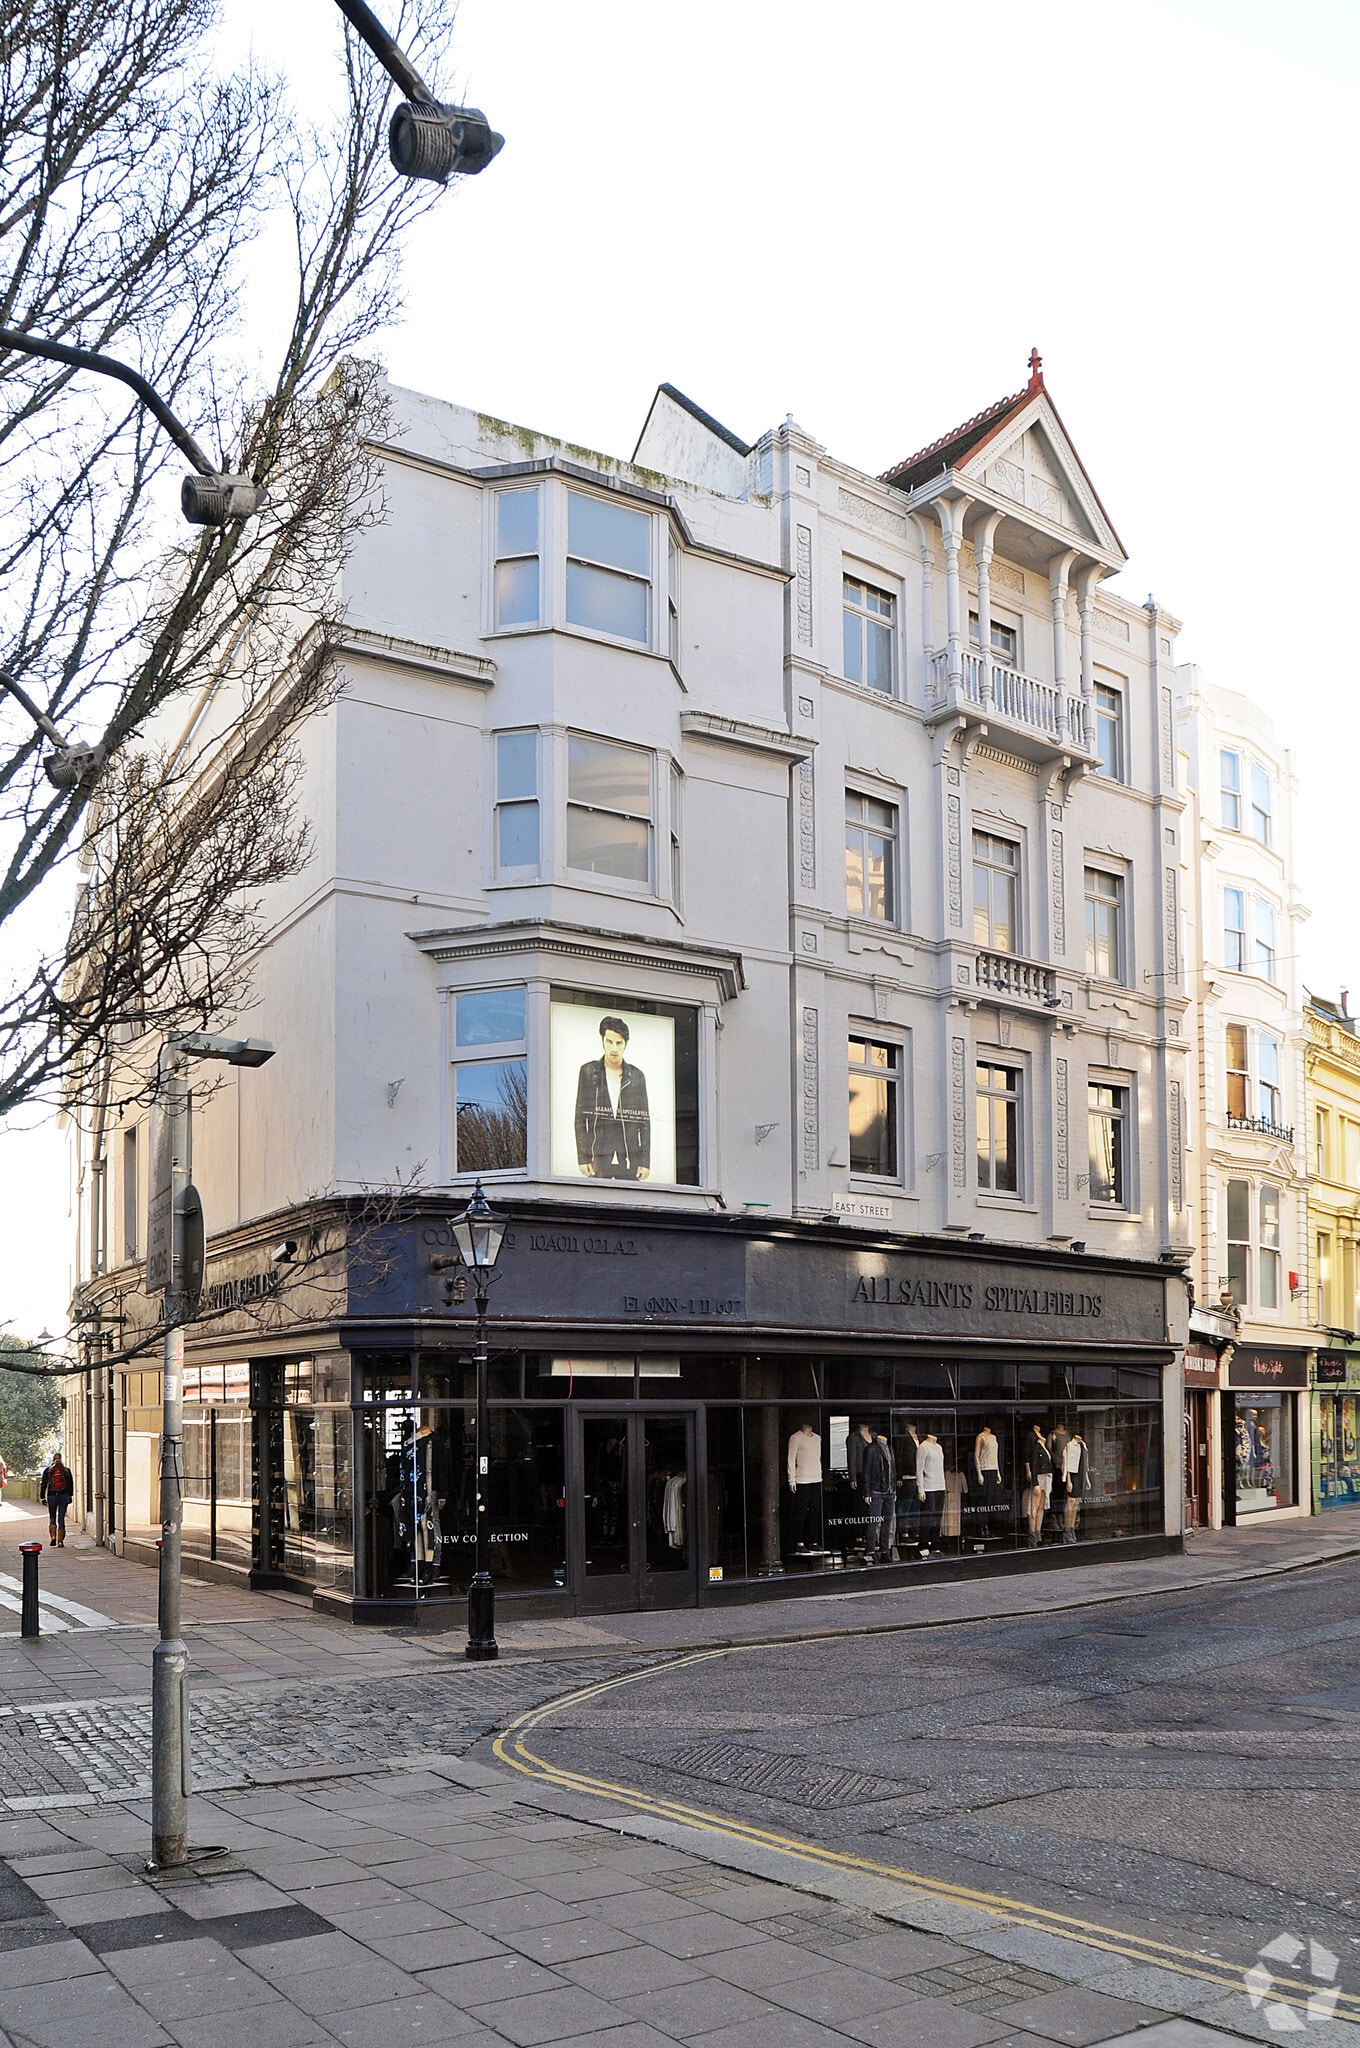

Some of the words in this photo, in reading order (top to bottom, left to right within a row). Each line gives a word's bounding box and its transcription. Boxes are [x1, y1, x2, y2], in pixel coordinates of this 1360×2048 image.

[835, 1202, 856, 1213] EAST
[859, 1204, 890, 1217] STREET
[852, 1275, 974, 1310] ALLSAINTS
[985, 1285, 1103, 1318] SPITALFIELDS
[963, 1506, 976, 1514] NEW
[977, 1504, 1010, 1513] COLLECTION
[828, 1518, 843, 1526] NEW
[844, 1515, 885, 1525] COLLECTION
[435, 1534, 459, 1544] NEW
[462, 1532, 529, 1544] COECTION
